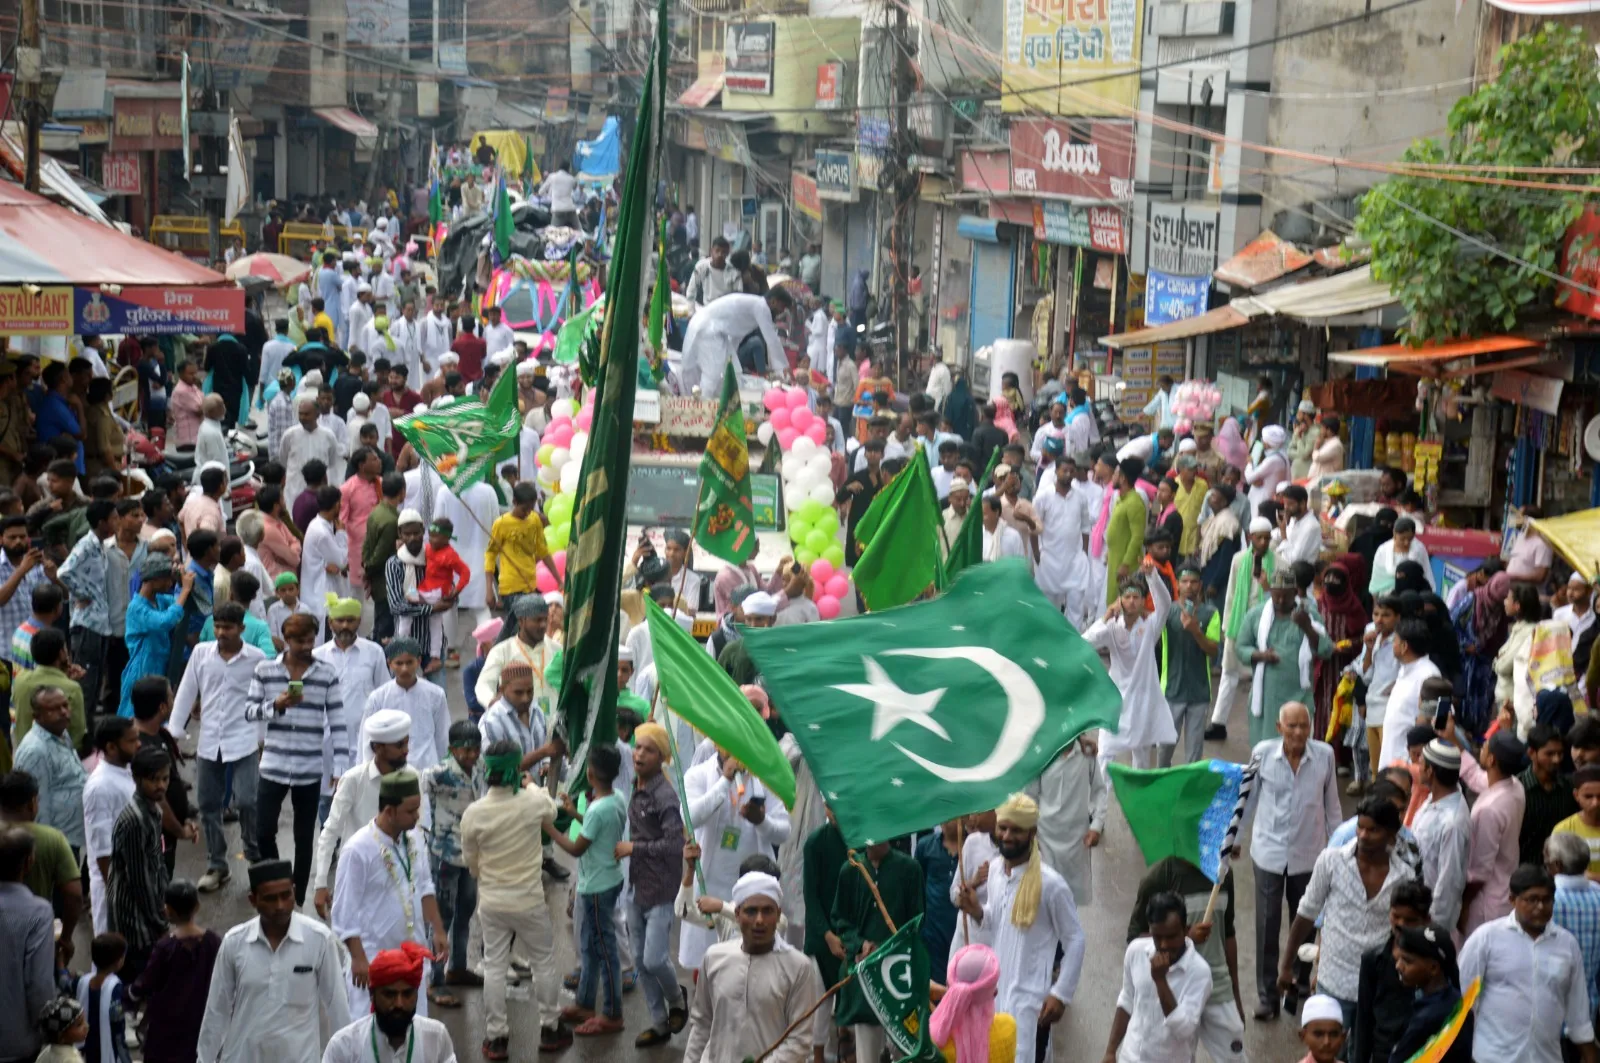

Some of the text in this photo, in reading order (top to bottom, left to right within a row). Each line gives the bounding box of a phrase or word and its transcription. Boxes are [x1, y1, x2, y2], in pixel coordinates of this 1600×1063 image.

[816, 161, 849, 184] CAMPUS
[1091, 205, 1119, 229] Bata
[1093, 228, 1121, 251] बाटा
[1153, 215, 1214, 250] STUDENT
[126, 306, 172, 324] पुलिस
